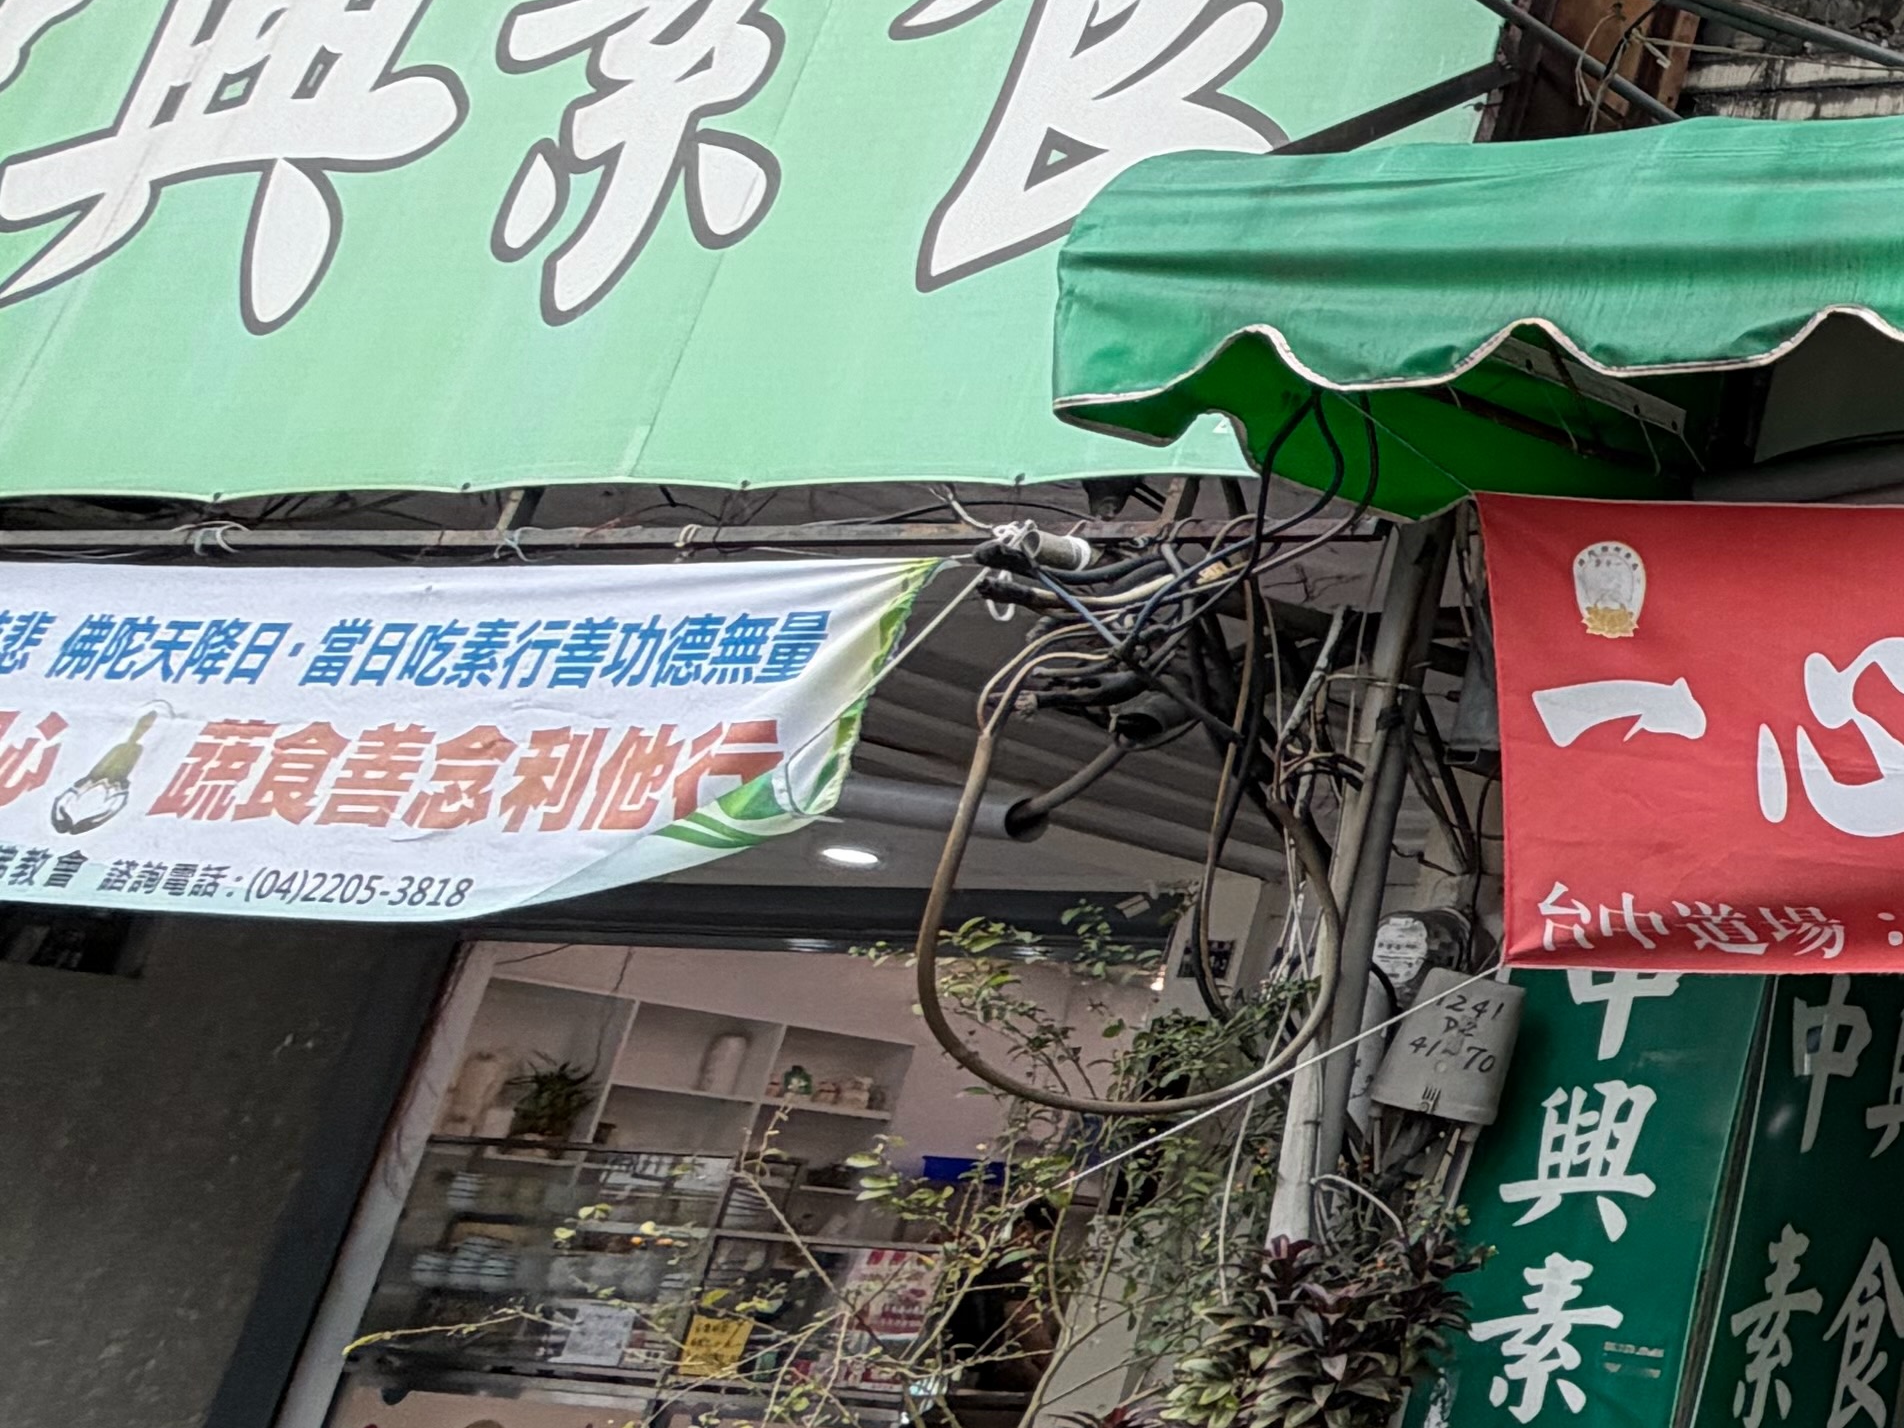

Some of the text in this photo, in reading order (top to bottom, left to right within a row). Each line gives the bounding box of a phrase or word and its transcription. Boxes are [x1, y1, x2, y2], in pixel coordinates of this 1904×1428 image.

[146, 716, 785, 836] 蔬食善念利他行
